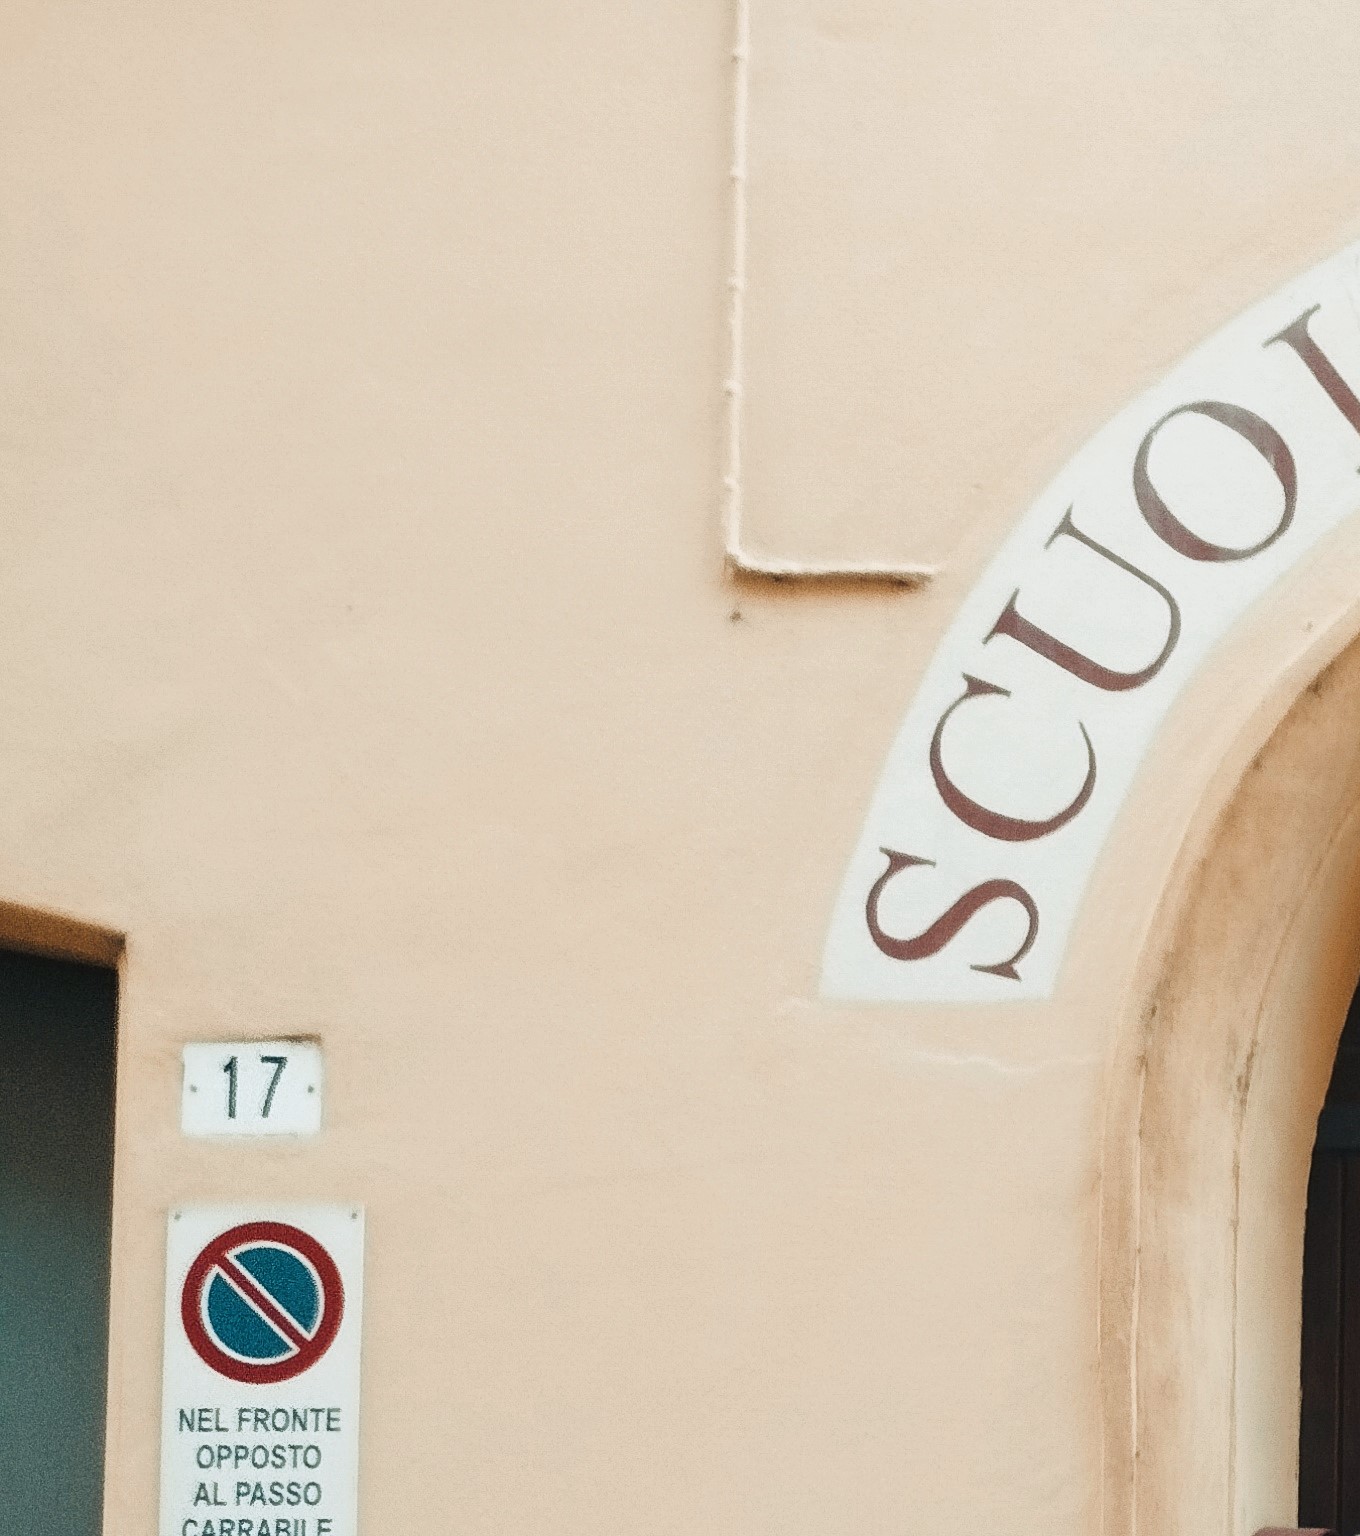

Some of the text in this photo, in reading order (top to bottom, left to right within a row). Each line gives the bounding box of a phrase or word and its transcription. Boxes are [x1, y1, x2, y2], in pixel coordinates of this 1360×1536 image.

[222, 1055, 289, 1120] 17
[178, 1407, 342, 1433] NEL FRONTE
[196, 1444, 323, 1470] OPPOSTO
[193, 1481, 323, 1507] AL PASSO
